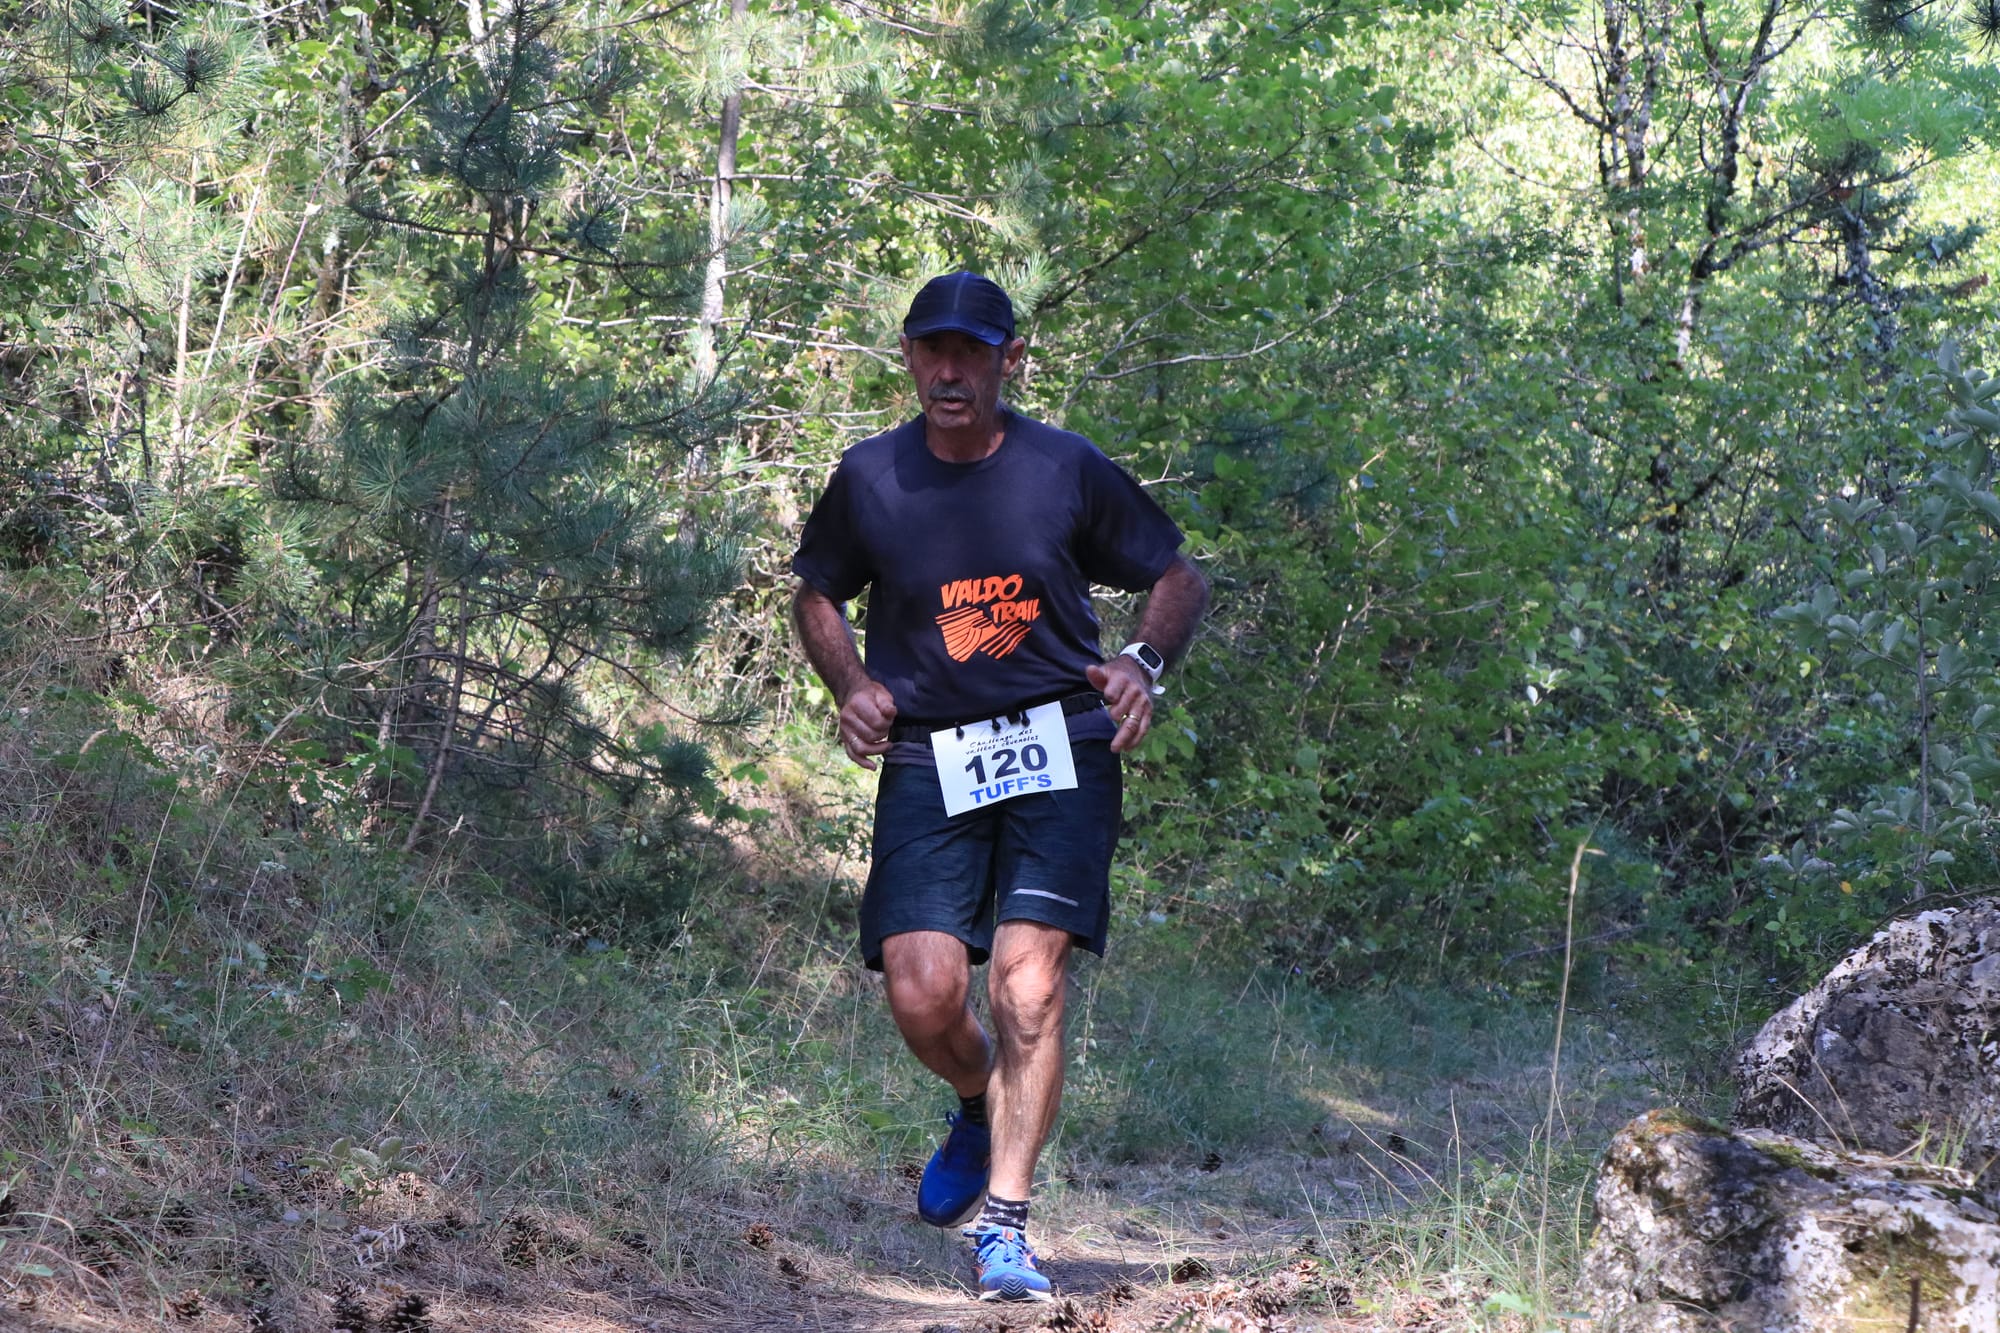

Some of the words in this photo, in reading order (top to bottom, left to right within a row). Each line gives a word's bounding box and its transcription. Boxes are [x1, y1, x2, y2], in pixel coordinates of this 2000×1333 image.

[941, 574, 1023, 609] VALDO
[990, 598, 1040, 624] TRAIL
[964, 743, 1048, 785] 120
[969, 773, 1052, 804] TUFF'S
